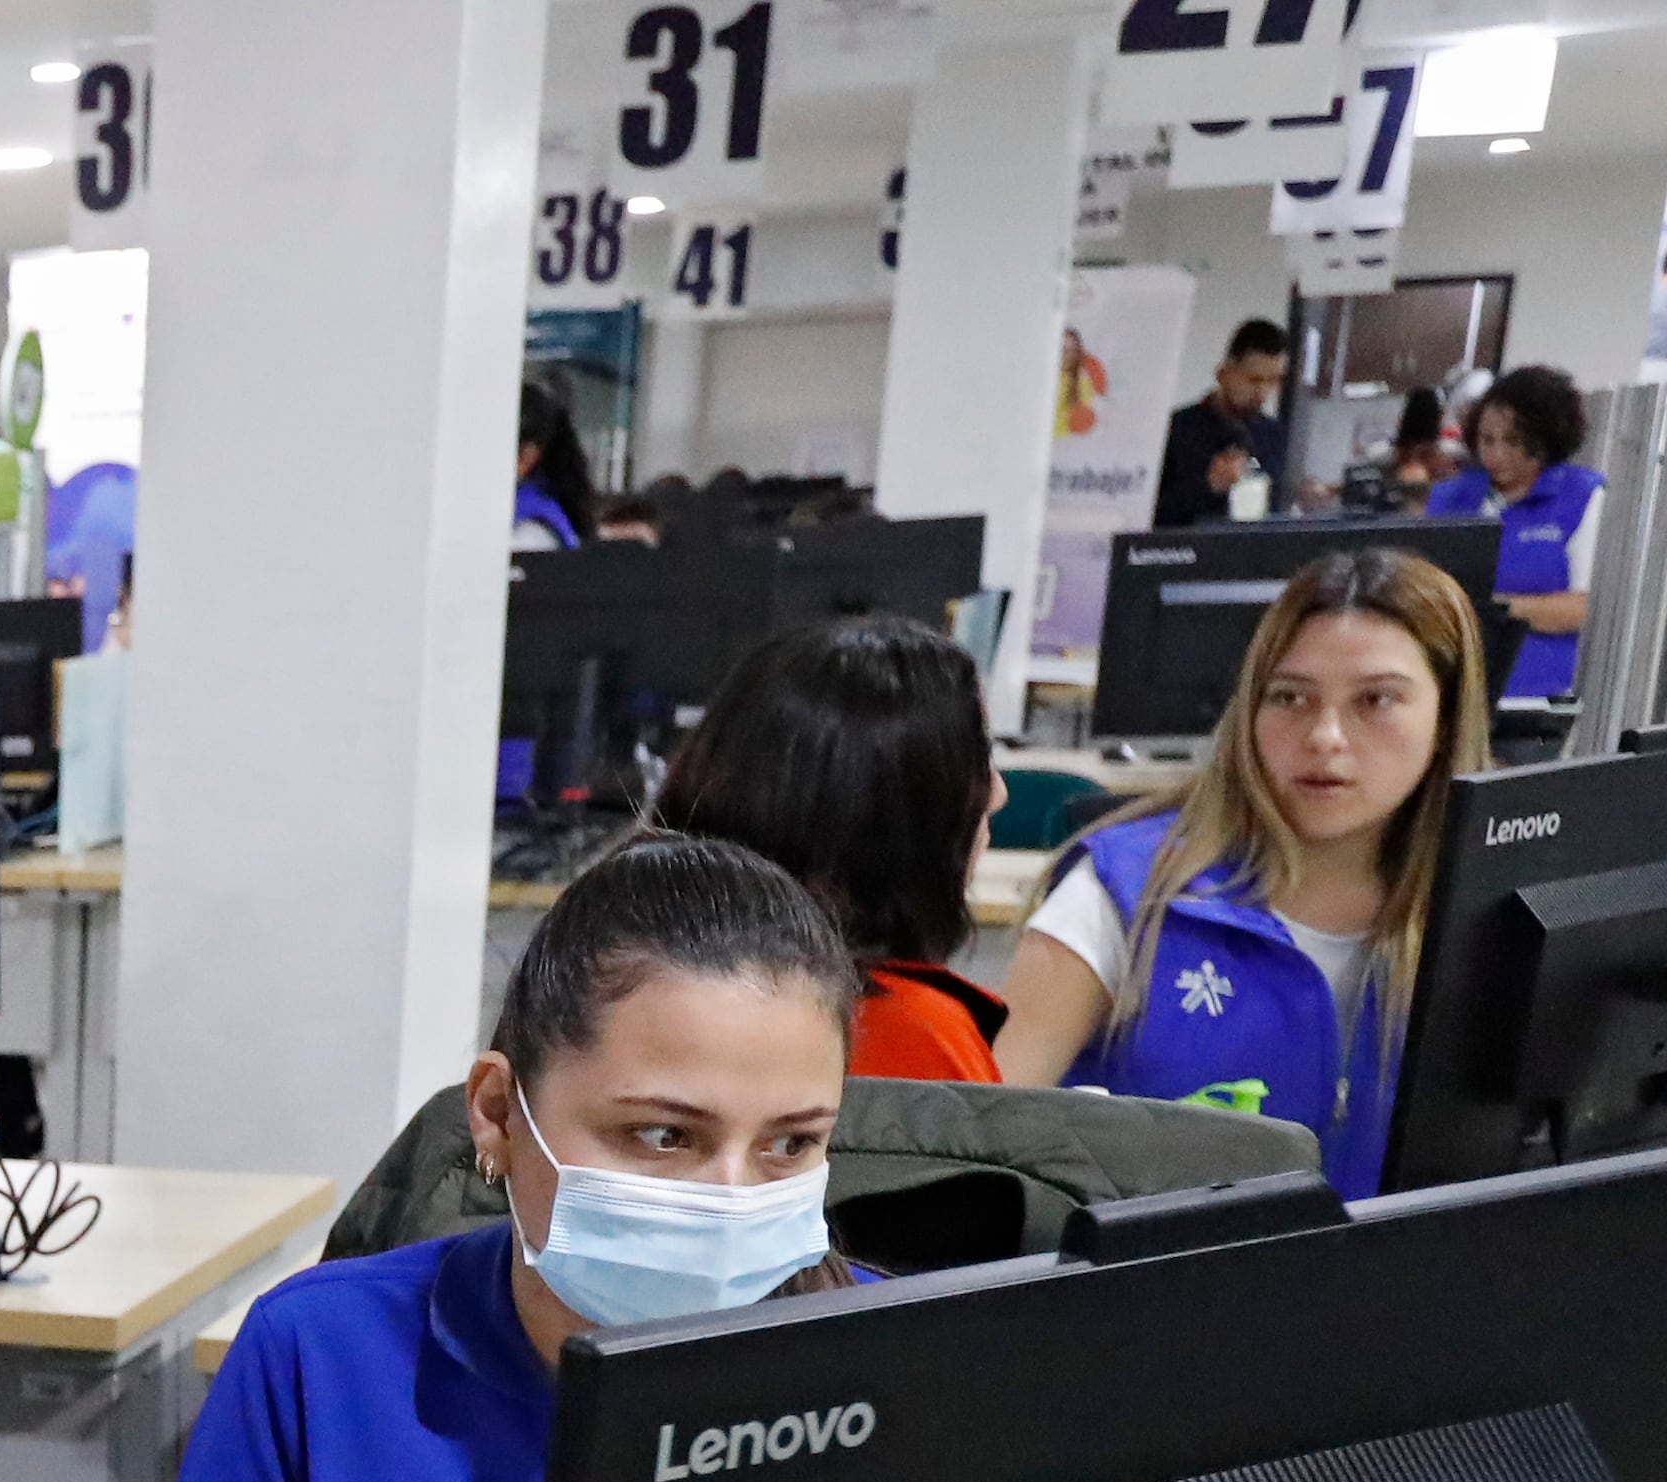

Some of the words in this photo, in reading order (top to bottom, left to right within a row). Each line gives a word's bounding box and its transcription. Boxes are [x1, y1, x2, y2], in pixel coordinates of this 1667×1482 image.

[620, 2, 772, 169] 31
[77, 63, 153, 212] 3
[538, 190, 626, 287] 38
[675, 225, 751, 308] 41
[1127, 546, 1198, 566] Lenovo
[1485, 809, 1561, 846] Lenovo
[654, 1402, 875, 1482] Lenovo
